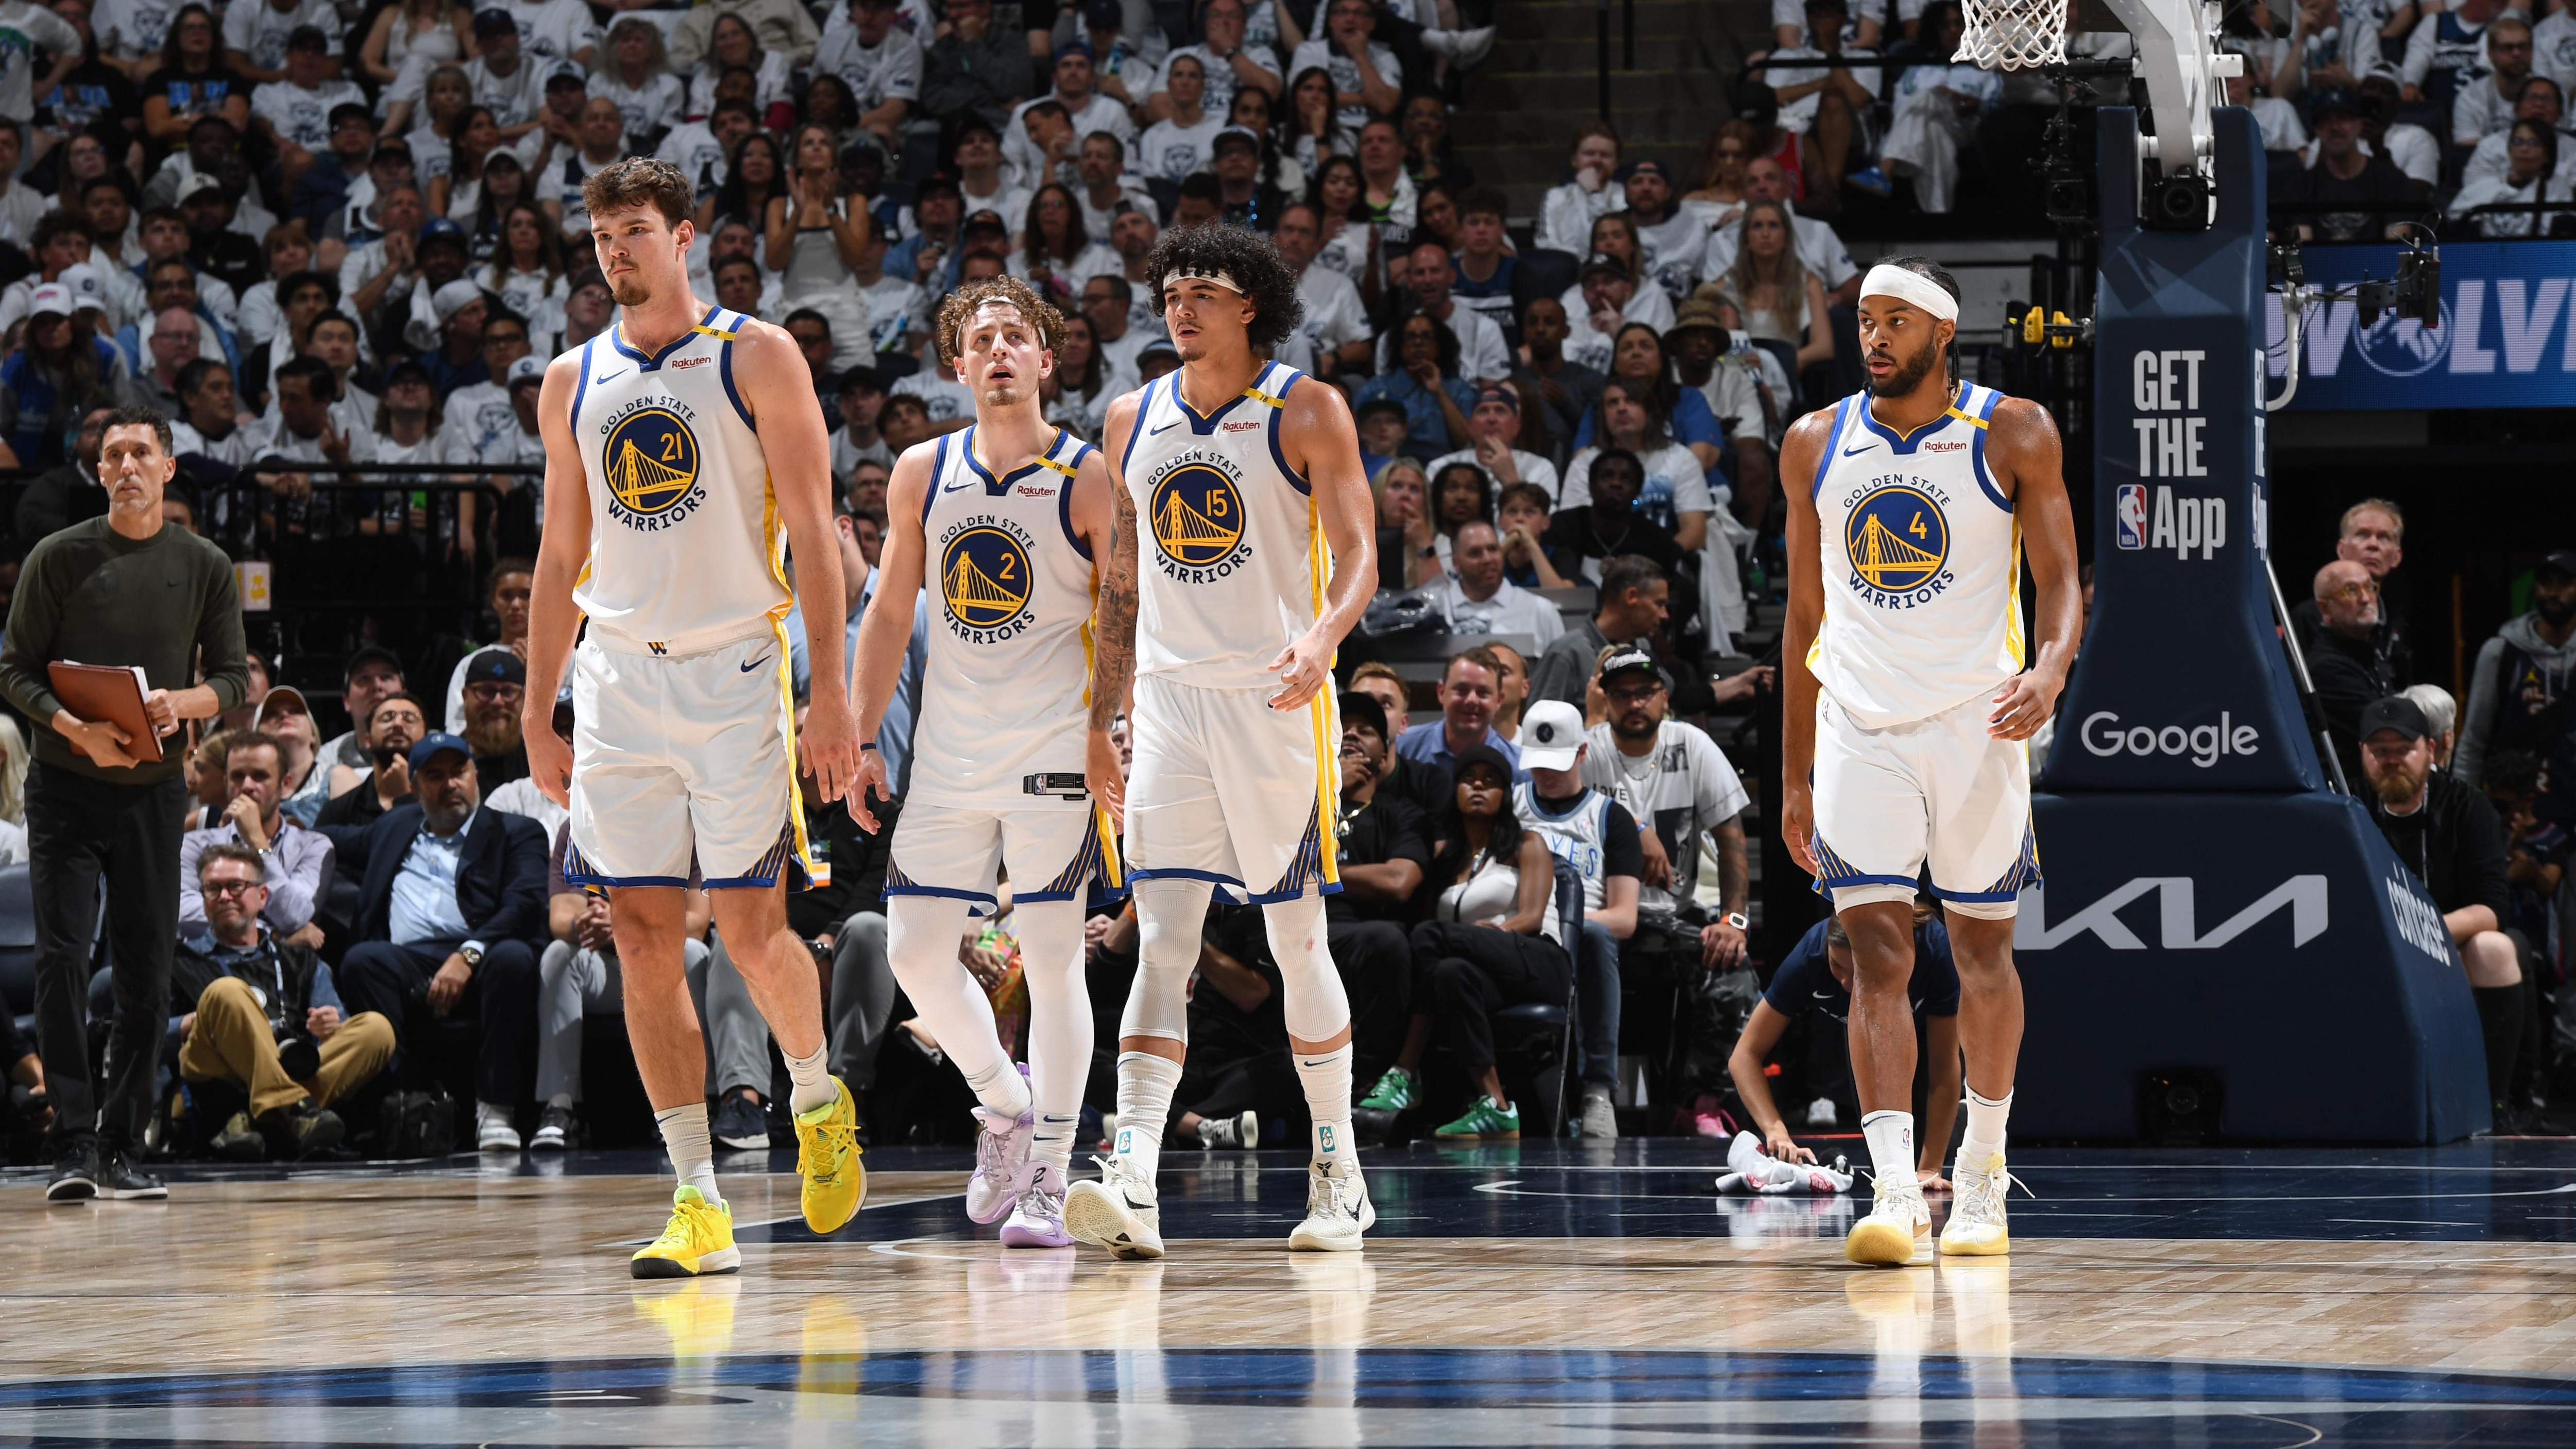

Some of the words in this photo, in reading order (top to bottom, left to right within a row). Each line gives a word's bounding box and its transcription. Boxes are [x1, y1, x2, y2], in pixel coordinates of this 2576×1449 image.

[672, 356, 711, 368] Rakuten
[1259, 394, 1268, 402] 16
[2133, 350, 2206, 411] GET
[600, 395, 653, 435] GOLDEN
[659, 396, 697, 422] STATE
[1223, 421, 1260, 431] Rakuten
[660, 431, 683, 462] 21
[1924, 441, 1967, 451] Rakuten
[2133, 417, 2208, 477] THE
[1053, 463, 1063, 471] 16
[1148, 451, 1202, 486] GOLDEN
[1208, 452, 1243, 482] STATE
[608, 486, 706, 532] WARRIORS
[1017, 485, 1056, 497] Rakuten
[1206, 489, 1228, 517] 15
[1843, 473, 1903, 509] GOLDEN
[1911, 476, 1951, 506] STATE
[940, 514, 995, 544] GOLDEN
[1001, 518, 1036, 551] STATE
[1909, 511, 1927, 540] 4
[2121, 534, 2136, 545] NBA
[2151, 485, 2226, 560] App
[999, 552, 1016, 579] 2
[1155, 543, 1253, 584] WARRIORS
[1849, 569, 1954, 609] WARRIORS
[943, 603, 1036, 645] WARRIORS
[2080, 710, 2260, 768] Google
[2386, 861, 2451, 967] coinbase
